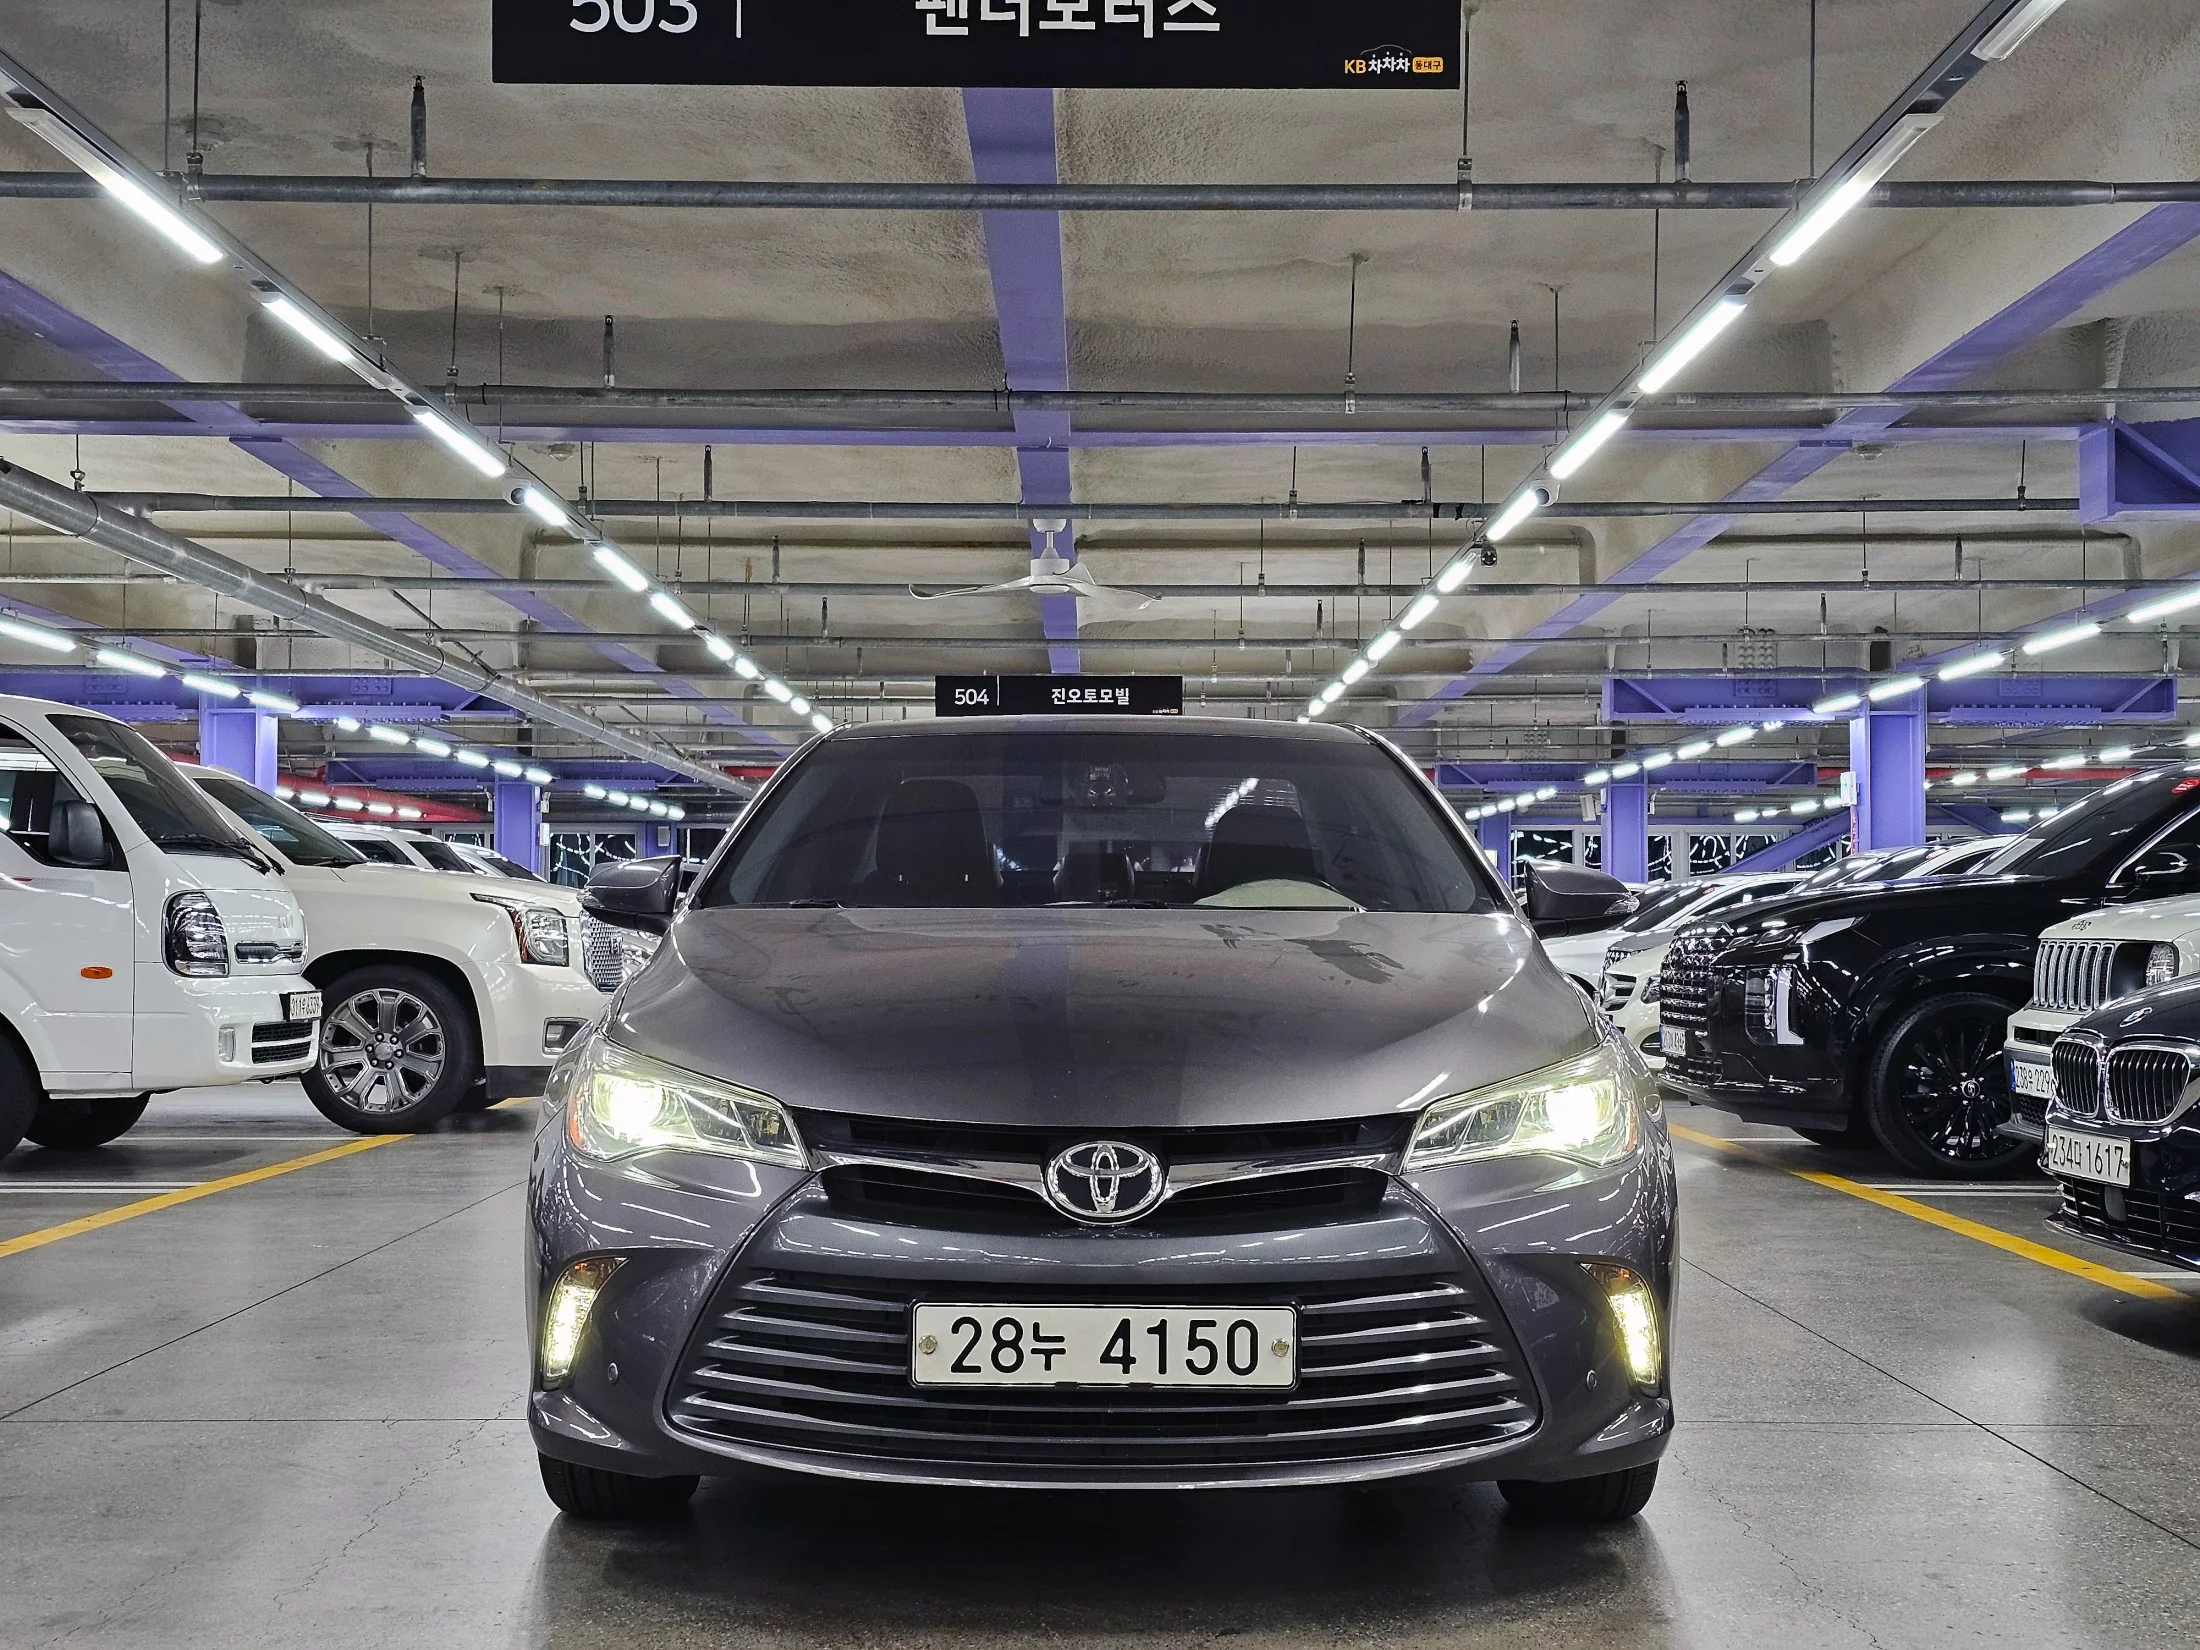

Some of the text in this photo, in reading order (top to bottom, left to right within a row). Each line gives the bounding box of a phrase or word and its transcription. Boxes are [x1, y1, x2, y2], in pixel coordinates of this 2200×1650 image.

[1414, 60, 1442, 71] 동대구
[954, 687, 1130, 706] 504 진오토모빌
[2050, 1133, 2124, 1178] 234마 1617
[950, 1316, 1260, 1377] 28누 4150
